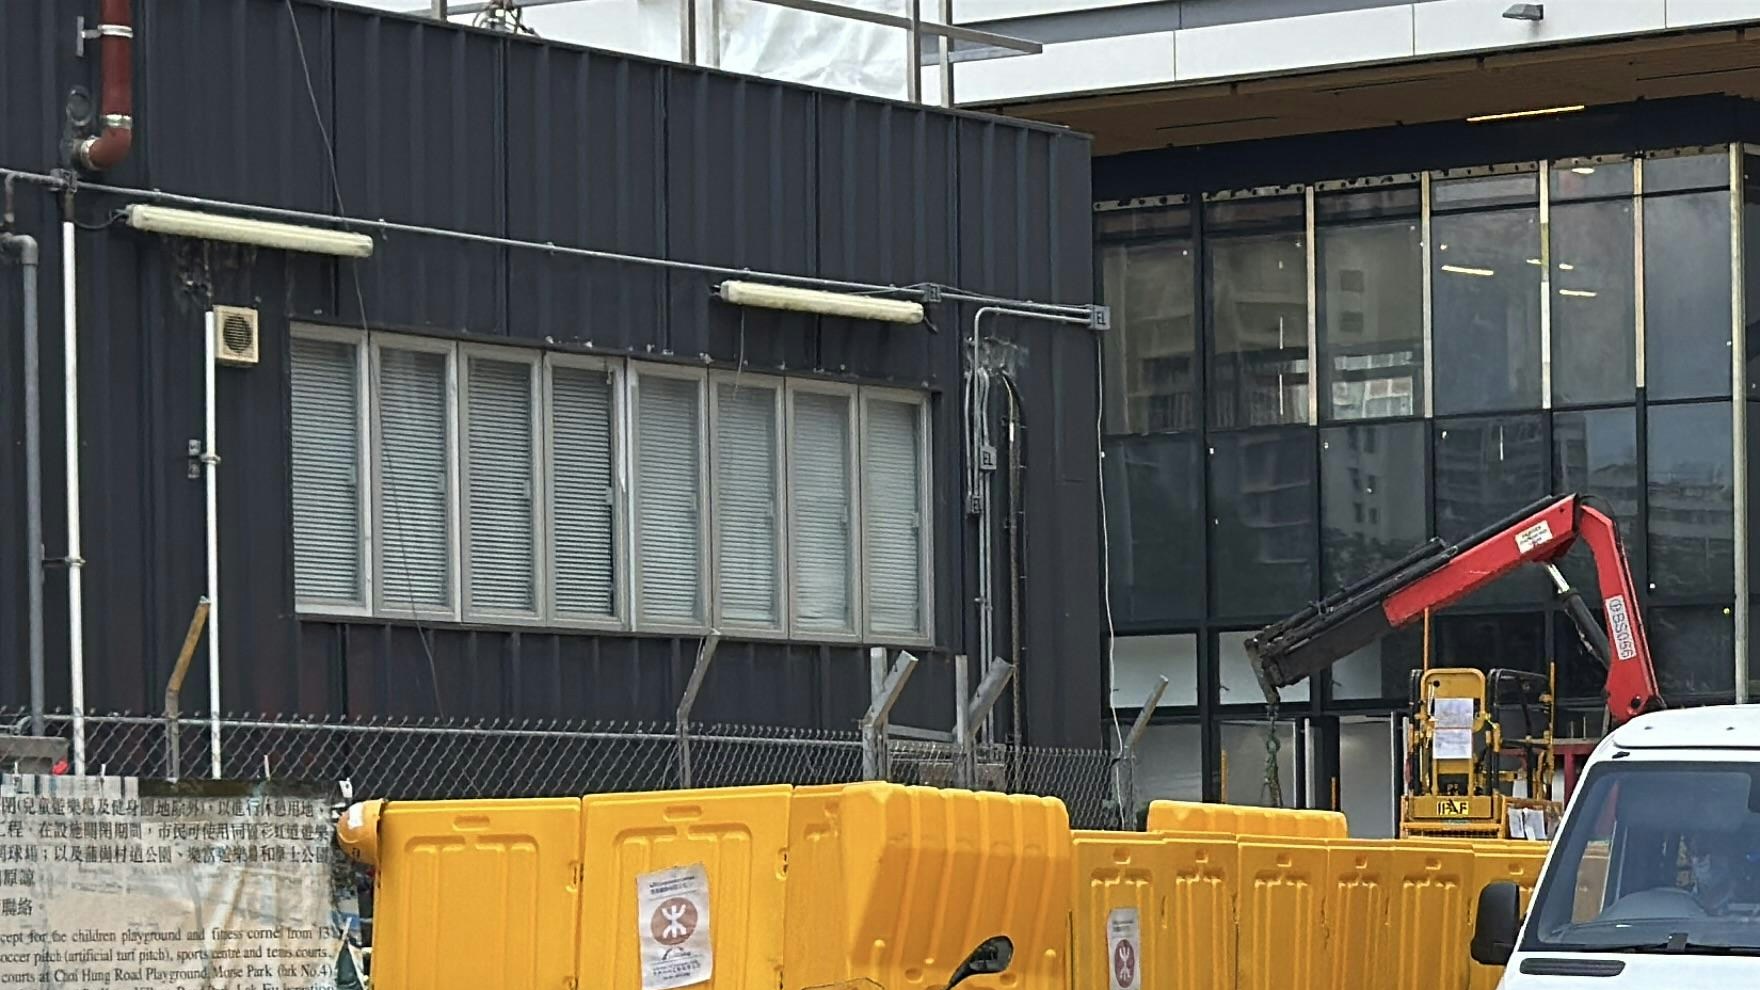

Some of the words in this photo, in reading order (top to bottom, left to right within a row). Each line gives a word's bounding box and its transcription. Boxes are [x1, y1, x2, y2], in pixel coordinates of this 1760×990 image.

[72, 929, 117, 942] children
[122, 929, 181, 945] playground
[187, 929, 205, 940] and
[176, 950, 208, 964] sports
[243, 946, 262, 958] and
[82, 969, 111, 985] Hung
[114, 968, 142, 982] Road
[247, 963, 273, 978] Park
